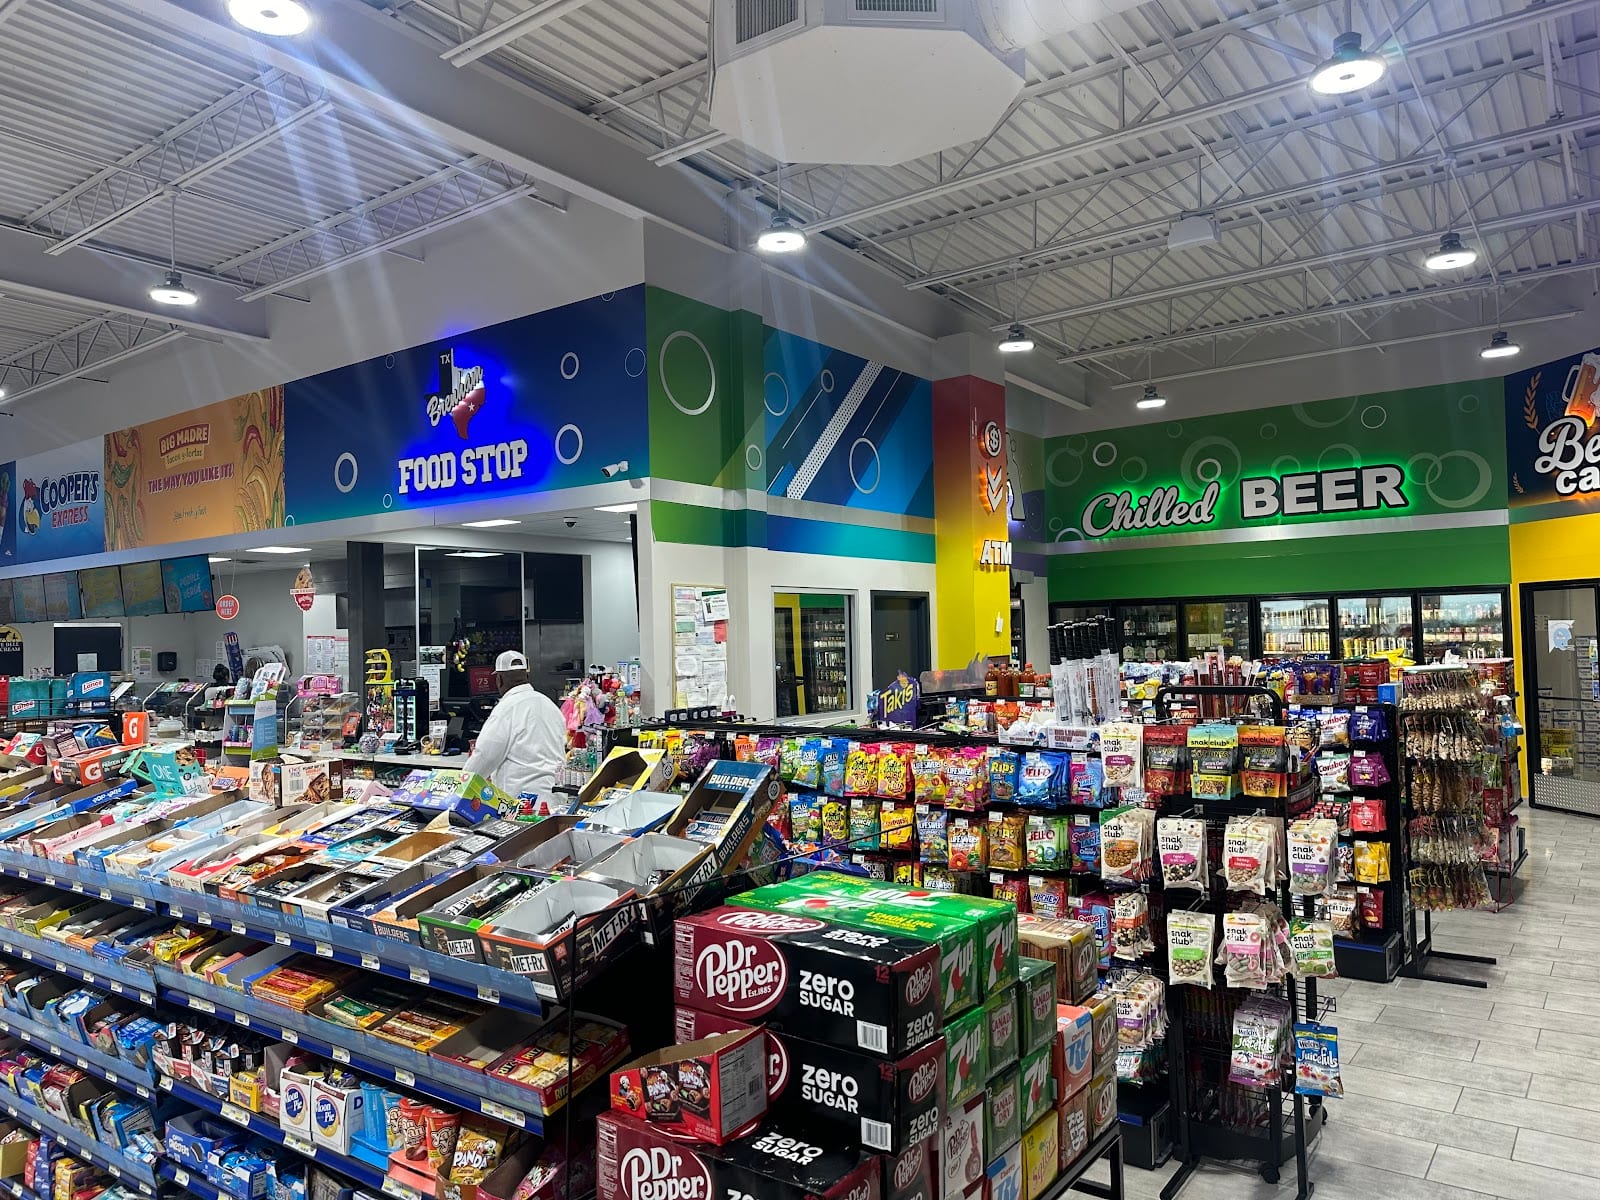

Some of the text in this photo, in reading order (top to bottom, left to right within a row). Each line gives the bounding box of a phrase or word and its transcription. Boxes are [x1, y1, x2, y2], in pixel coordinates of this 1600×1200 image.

[440, 353, 451, 364] TX
[427, 365, 484, 427] Brenham
[160, 426, 208, 454] BIG MADRE
[398, 439, 528, 494] FOOD STOP
[148, 463, 235, 494] THE WAY YOU LIKE IT!
[40, 471, 100, 514] COOPER'S
[1080, 463, 1410, 538] Chilled BEER
[51, 506, 89, 528] EXPRESS
[980, 540, 1012, 565] ATM
[83, 679, 103, 692] Lance
[880, 683, 914, 719] Takis
[128, 717, 139, 739] G
[1103, 738, 1122, 746] snak
[1103, 745, 1120, 753] club
[84, 763, 102, 781] G
[152, 763, 175, 781] ONE
[709, 774, 757, 789] BUILDERS
[429, 780, 459, 792] PUNCH
[1029, 829, 1056, 841] JELL-O
[1103, 824, 1123, 832] snak
[1103, 830, 1121, 838] club
[718, 815, 750, 862] BUILDERS
[1161, 835, 1182, 844] snak
[1161, 842, 1181, 851] club
[1228, 846, 1245, 854] club
[1292, 845, 1314, 854] snak
[1292, 853, 1312, 861] club
[283, 914, 305, 929] KIND
[866, 910, 937, 930] LEMON LIME
[376, 924, 410, 943] BUILDERS
[822, 932, 882, 949] SUGAR
[836, 928, 890, 944] zero
[1171, 930, 1192, 939] snak
[1171, 937, 1190, 946] club
[1293, 935, 1315, 943] snak
[1294, 941, 1314, 949] club
[726, 939, 758, 973] Dr
[696, 943, 780, 1003] Pepper
[875, 965, 890, 979] 12
[914, 966, 926, 982] Dr
[799, 969, 855, 999] zero
[906, 969, 932, 1004] Pepper
[799, 990, 855, 1018] SUGAR
[1117, 1002, 1133, 1010] nak
[906, 1011, 935, 1038] zero
[906, 1027, 935, 1050] SUGAR
[521, 1047, 542, 1060] RITZ
[1066, 1031, 1091, 1070] RC
[1297, 1046, 1339, 1069] Juicefuls
[497, 1060, 518, 1076] RITZ
[878, 1062, 894, 1077] 12
[918, 1062, 930, 1079] Dr
[802, 1063, 859, 1097] zero
[908, 1065, 937, 1101] Pepper
[802, 1085, 859, 1115] SUGAR
[985, 1086, 993, 1099] 12
[293, 1100, 303, 1112] Pie
[324, 1111, 336, 1123] Pie
[909, 1106, 939, 1134] zero
[1075, 1109, 1086, 1141] BIG
[909, 1121, 939, 1148] SUGAR
[1066, 1111, 1081, 1152] RED
[751, 1140, 816, 1167] SUGAR
[760, 1131, 824, 1159] zero
[453, 1149, 488, 1169] PANDA
[650, 1147, 683, 1178] Dr
[620, 1147, 705, 1200] Pepper
